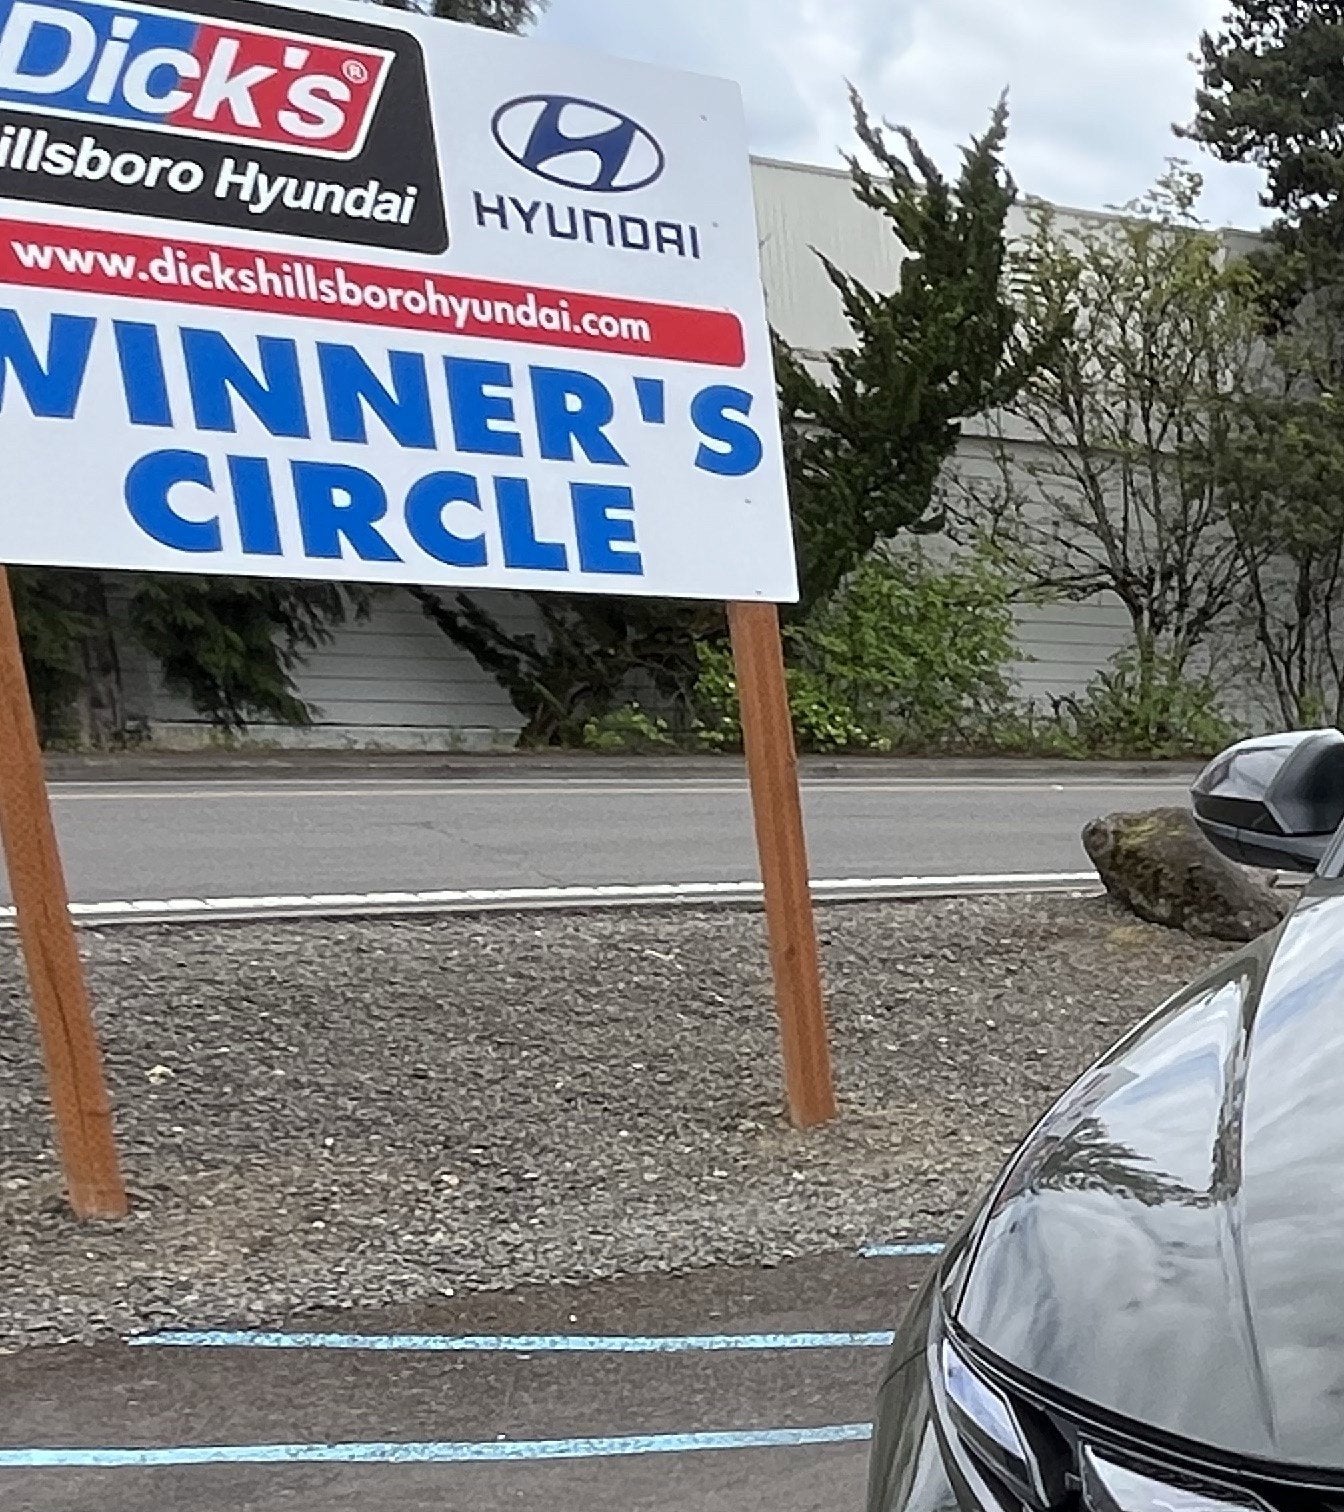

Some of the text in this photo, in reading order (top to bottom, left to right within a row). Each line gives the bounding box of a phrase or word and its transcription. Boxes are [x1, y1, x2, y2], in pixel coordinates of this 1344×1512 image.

[0, 124, 418, 225] illsboro Hyundai
[472, 190, 700, 260] HYUNDAI
[10, 240, 652, 343] www.dickshillsborohyundai.com
[124, 448, 644, 576] CIRCLE
